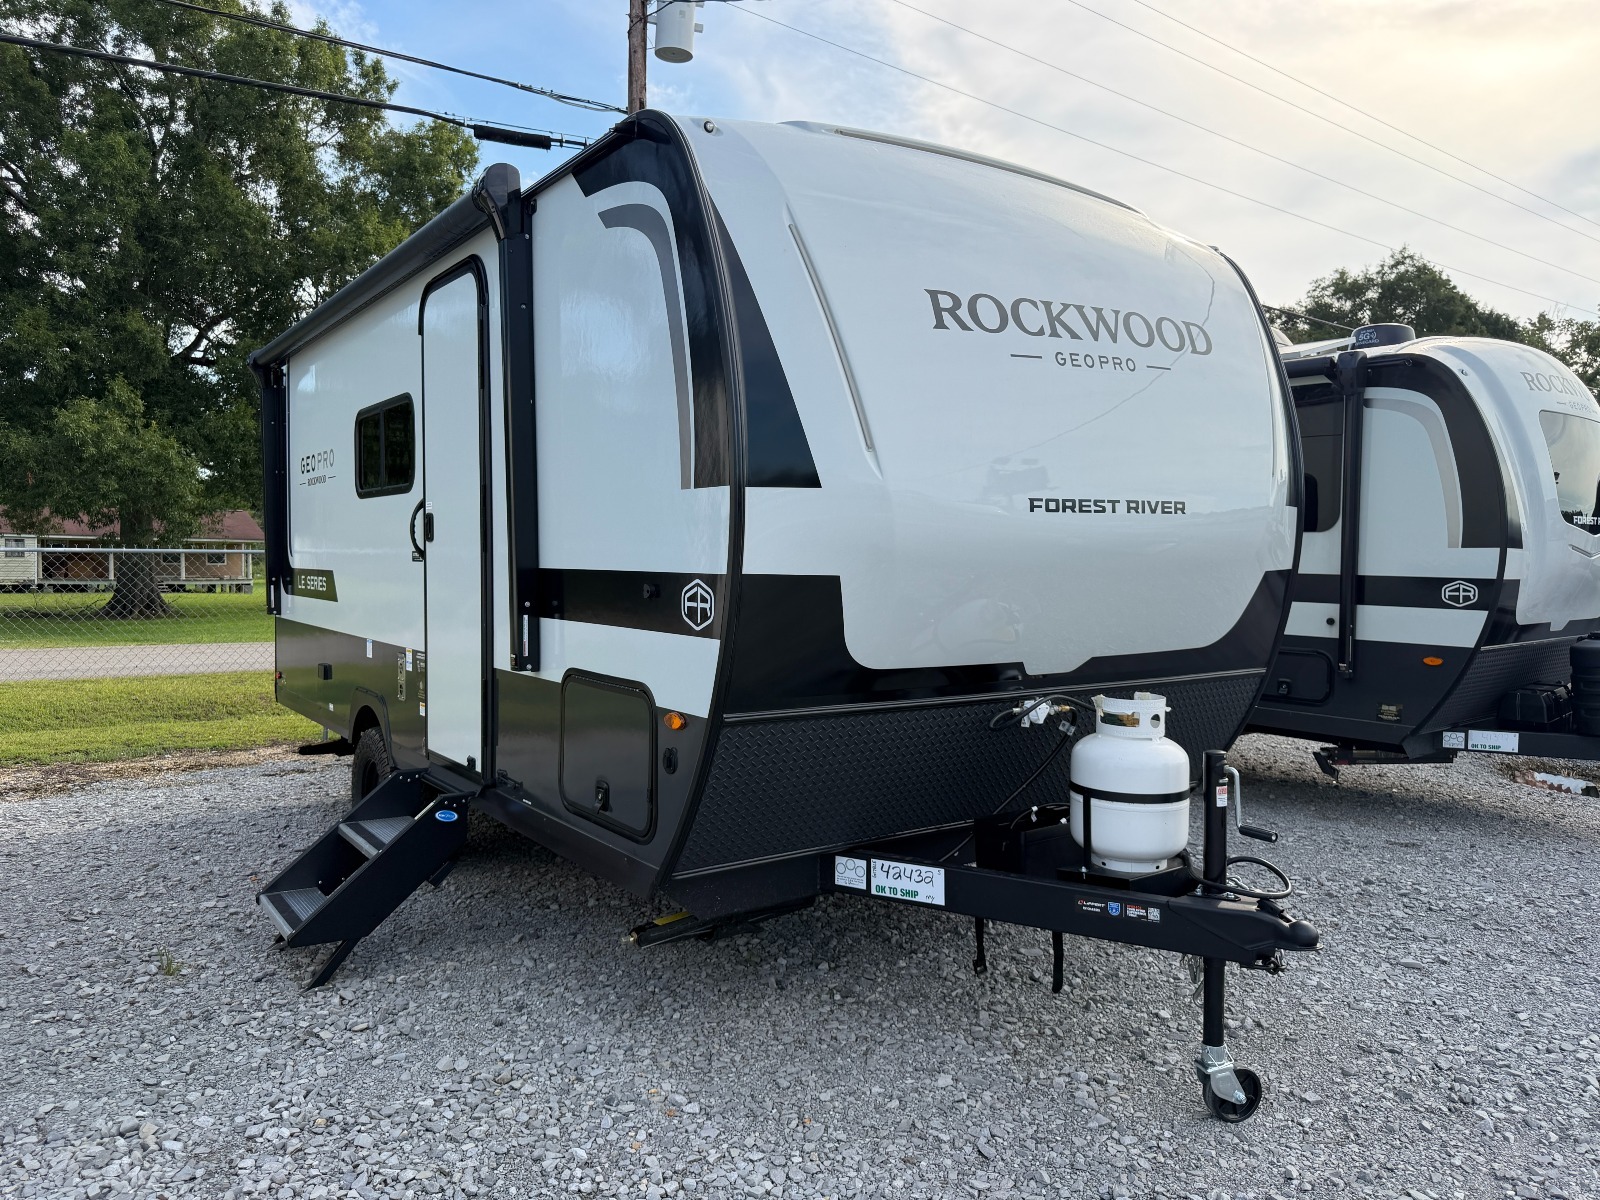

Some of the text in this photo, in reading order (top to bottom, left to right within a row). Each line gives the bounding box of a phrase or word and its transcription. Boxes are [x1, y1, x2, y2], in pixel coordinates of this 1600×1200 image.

[924, 288, 1213, 356] ROCKWOOD
[1054, 351, 1136, 372] GEOPRO
[300, 448, 335, 475] GEOPRO
[1028, 497, 1187, 515] FOREST RIVER
[1573, 515, 1598, 525] FOREST
[297, 574, 327, 592] LE SERIES
[875, 884, 919, 899] OK TO SHIP
